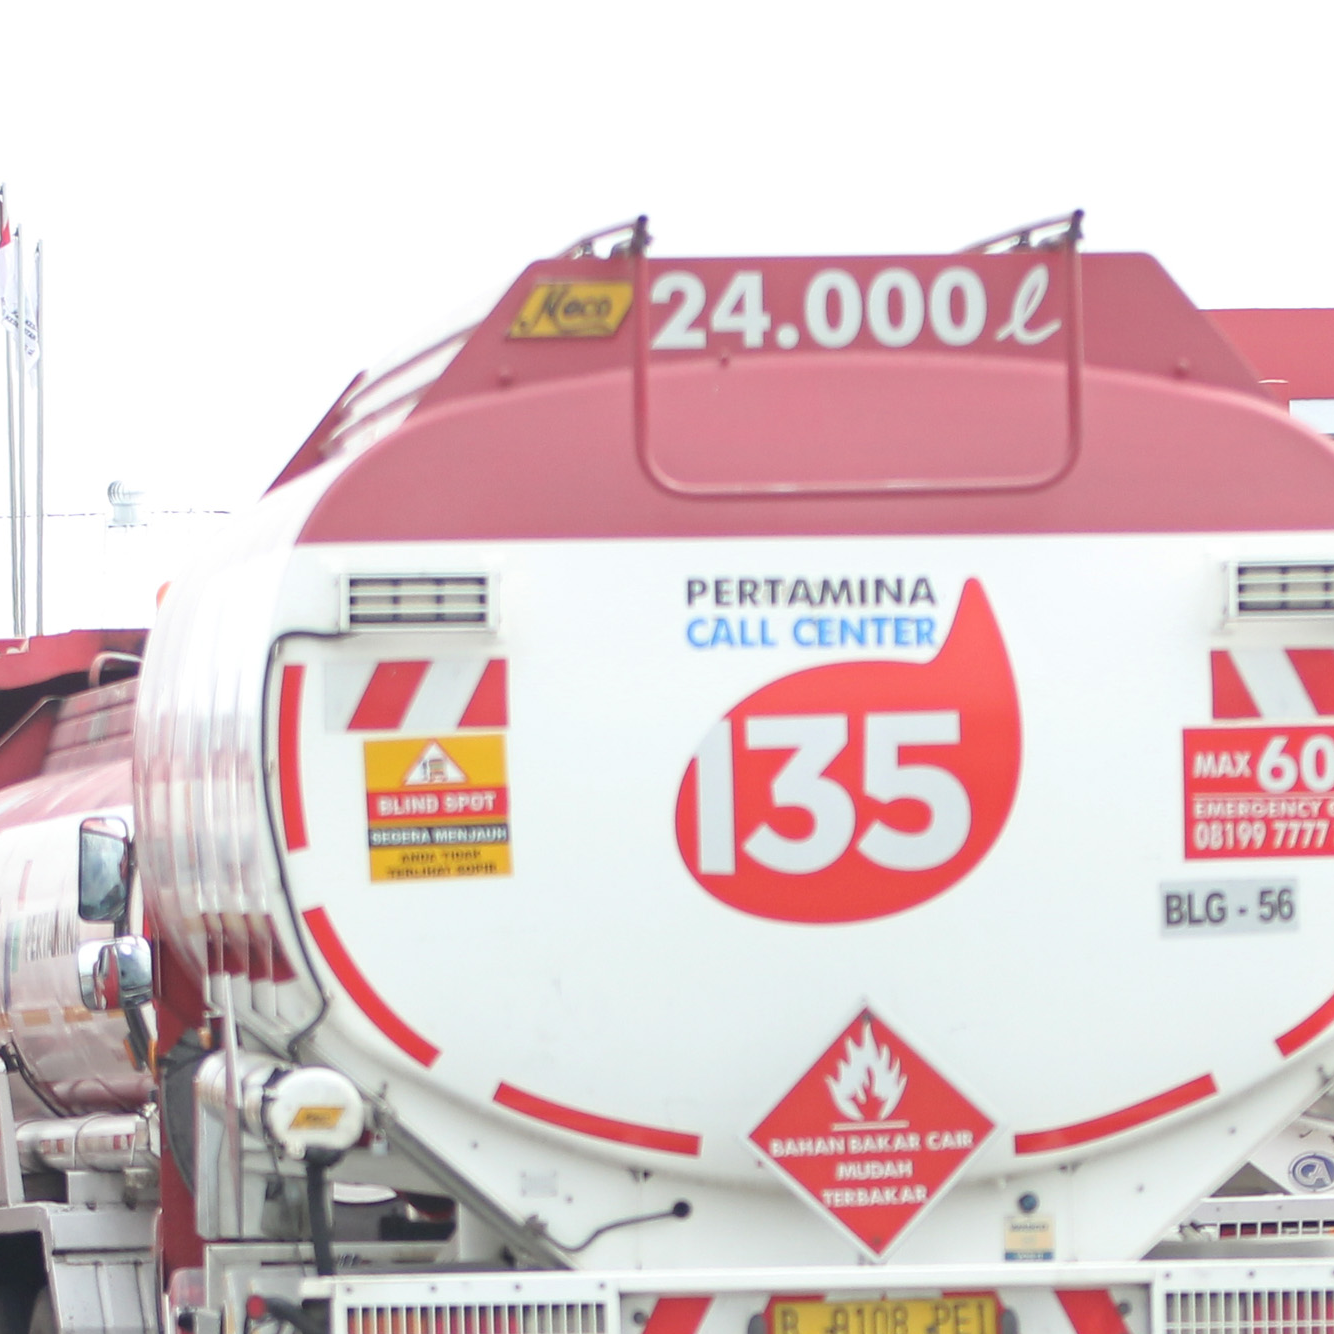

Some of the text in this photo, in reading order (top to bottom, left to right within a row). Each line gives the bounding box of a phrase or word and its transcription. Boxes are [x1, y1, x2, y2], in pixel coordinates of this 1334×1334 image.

[650, 267, 987, 351] 24.000
[686, 577, 937, 608] PERTAMINA
[686, 616, 937, 649] CALL CENTER
[1193, 751, 1252, 779] MAX
[378, 791, 497, 817] BLIND SPOT
[695, 709, 973, 876] 135
[1193, 799, 1323, 819] EMERGENCY
[371, 825, 508, 846] SEGERA MENJAUH
[1193, 820, 1267, 851] 08199
[1271, 819, 1330, 850] 7777
[1165, 891, 1227, 926] BLG
[1258, 888, 1294, 924] 56
[770, 1130, 974, 1157] BAHAN BAKAR CAIR
[836, 1160, 913, 1181] MUDAH
[822, 1185, 928, 1208] TERBAKAR
